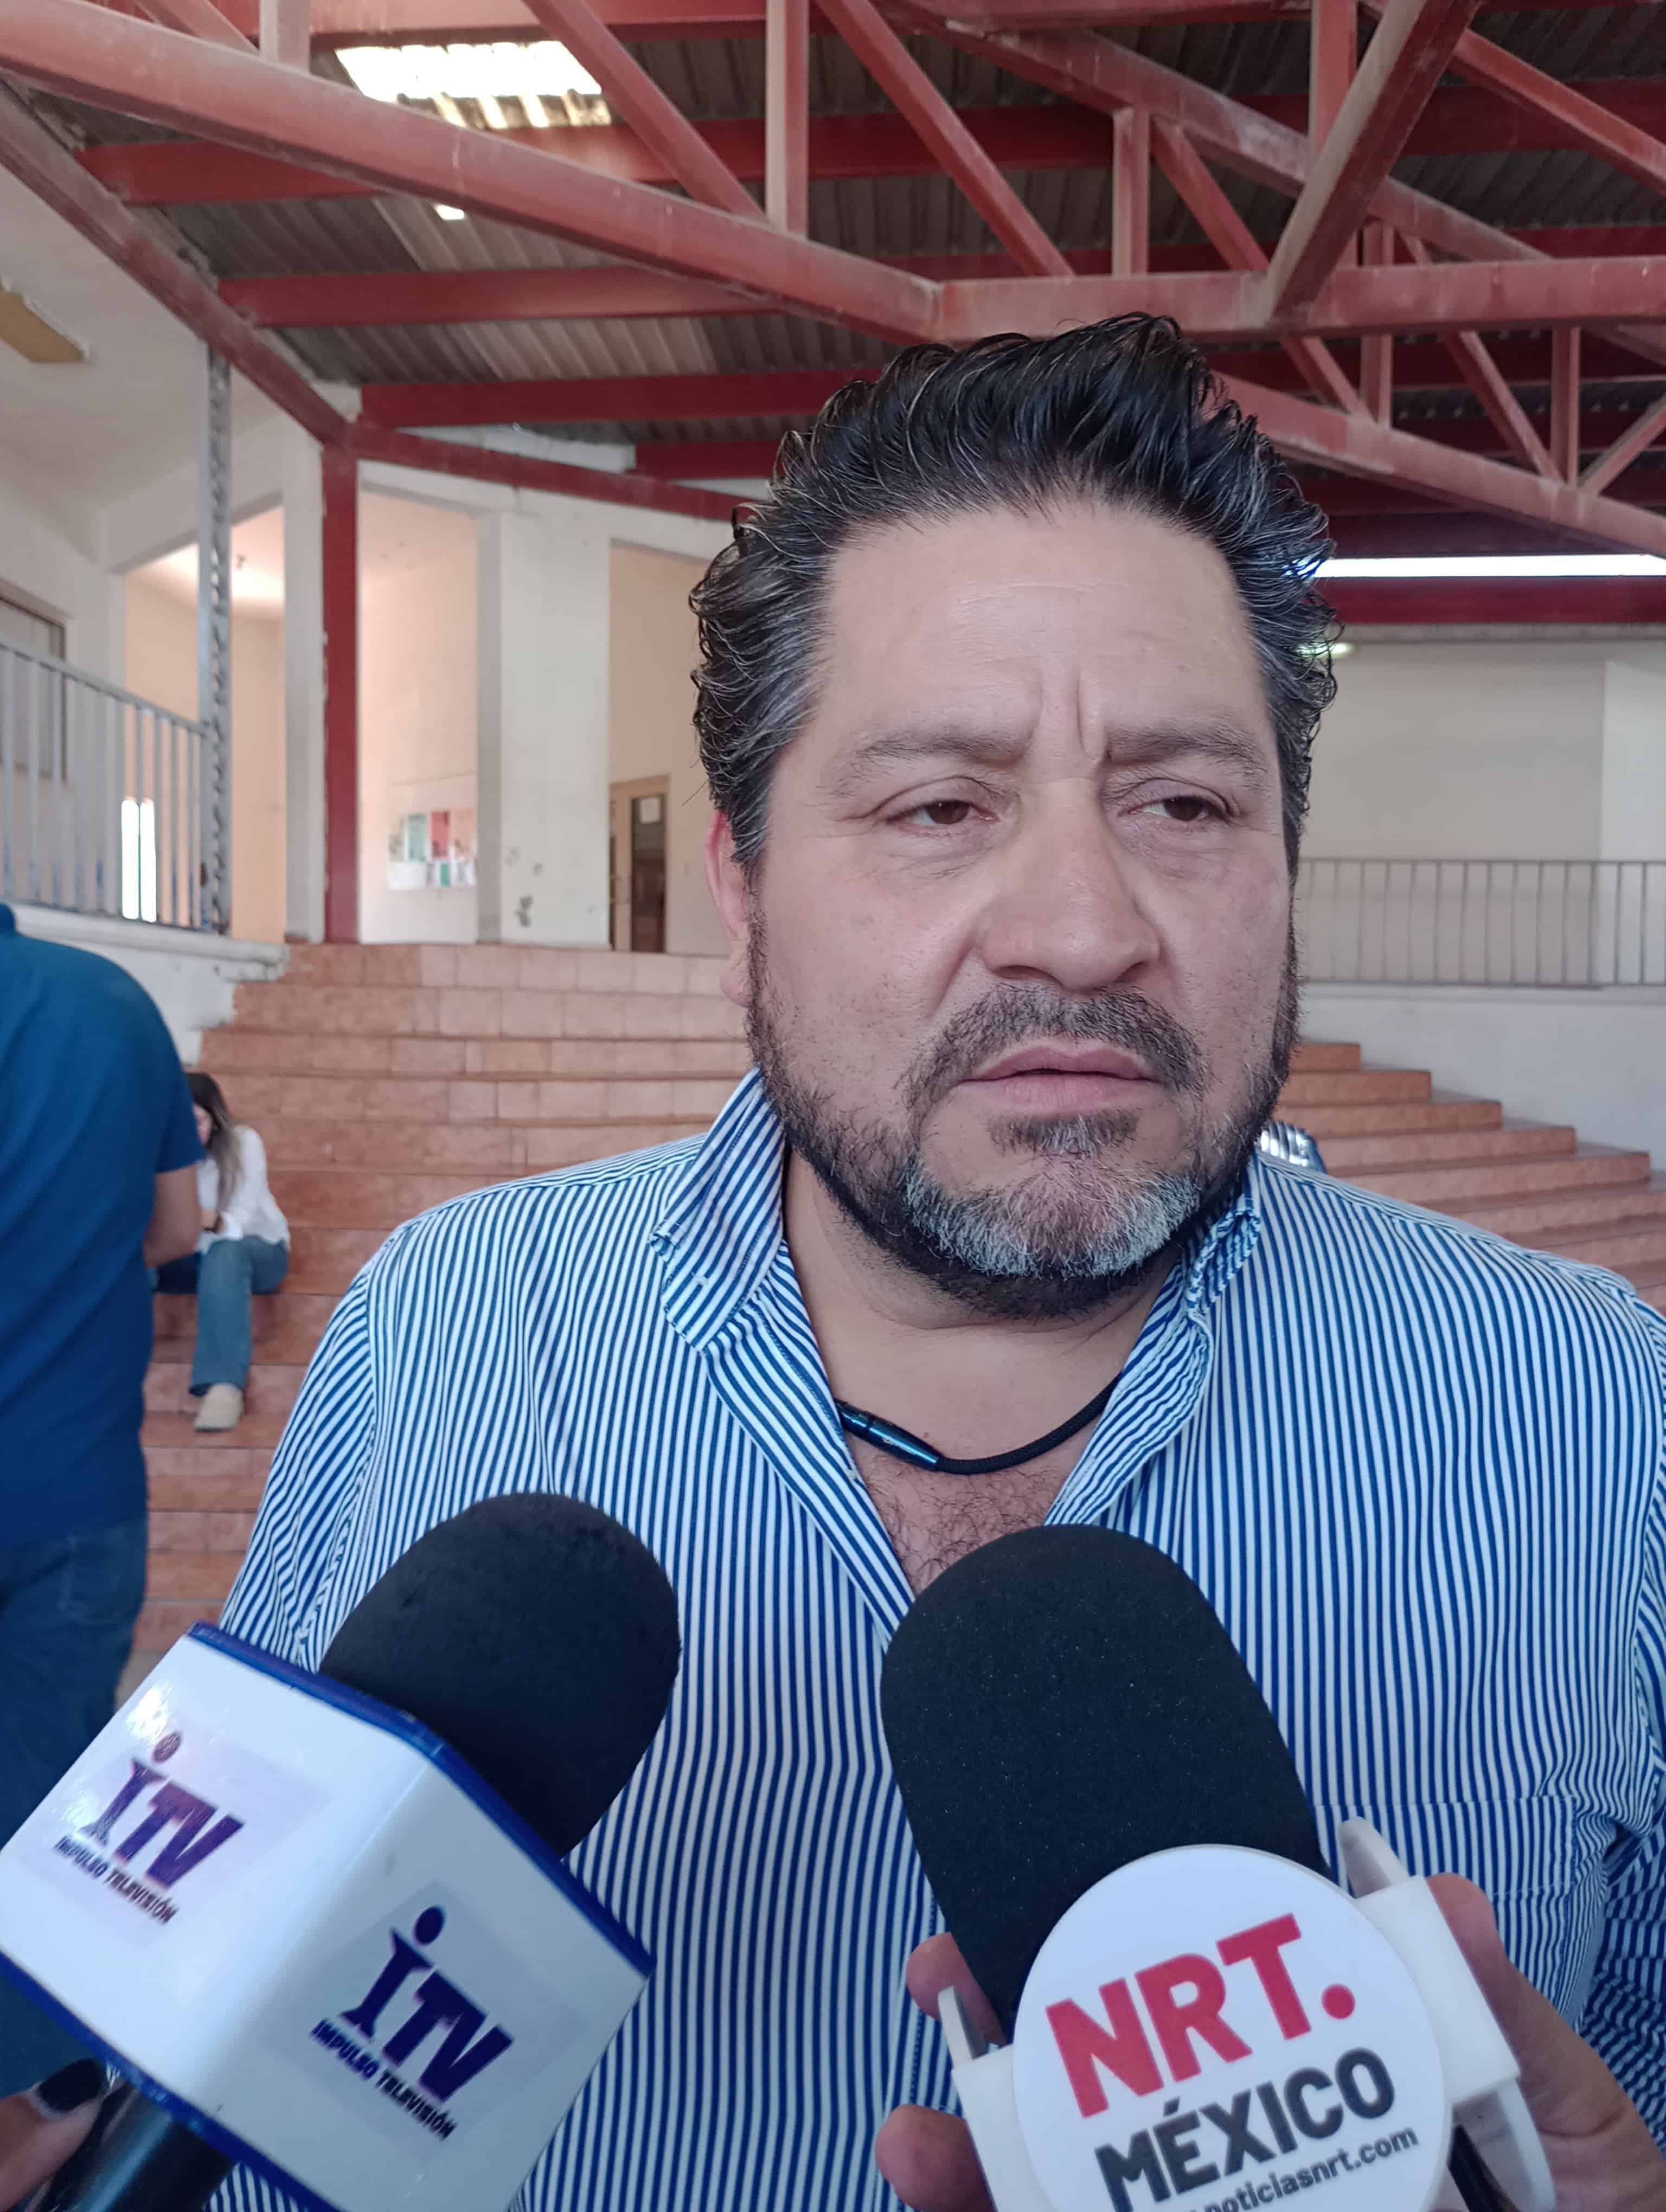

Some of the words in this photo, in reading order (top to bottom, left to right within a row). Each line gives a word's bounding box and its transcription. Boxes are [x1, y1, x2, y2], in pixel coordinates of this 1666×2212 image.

[53, 1835, 109, 1879] IMPULSO
[104, 1868, 180, 1925] TELEVISIÓN
[311, 2018, 380, 2081] IMPULSO
[375, 2068, 457, 2141] TELEVISIÓN
[338, 1905, 514, 2102] iTV
[1045, 1912, 1355, 2119] NRT.
[1094, 2047, 1395, 2212] MÉXICO
